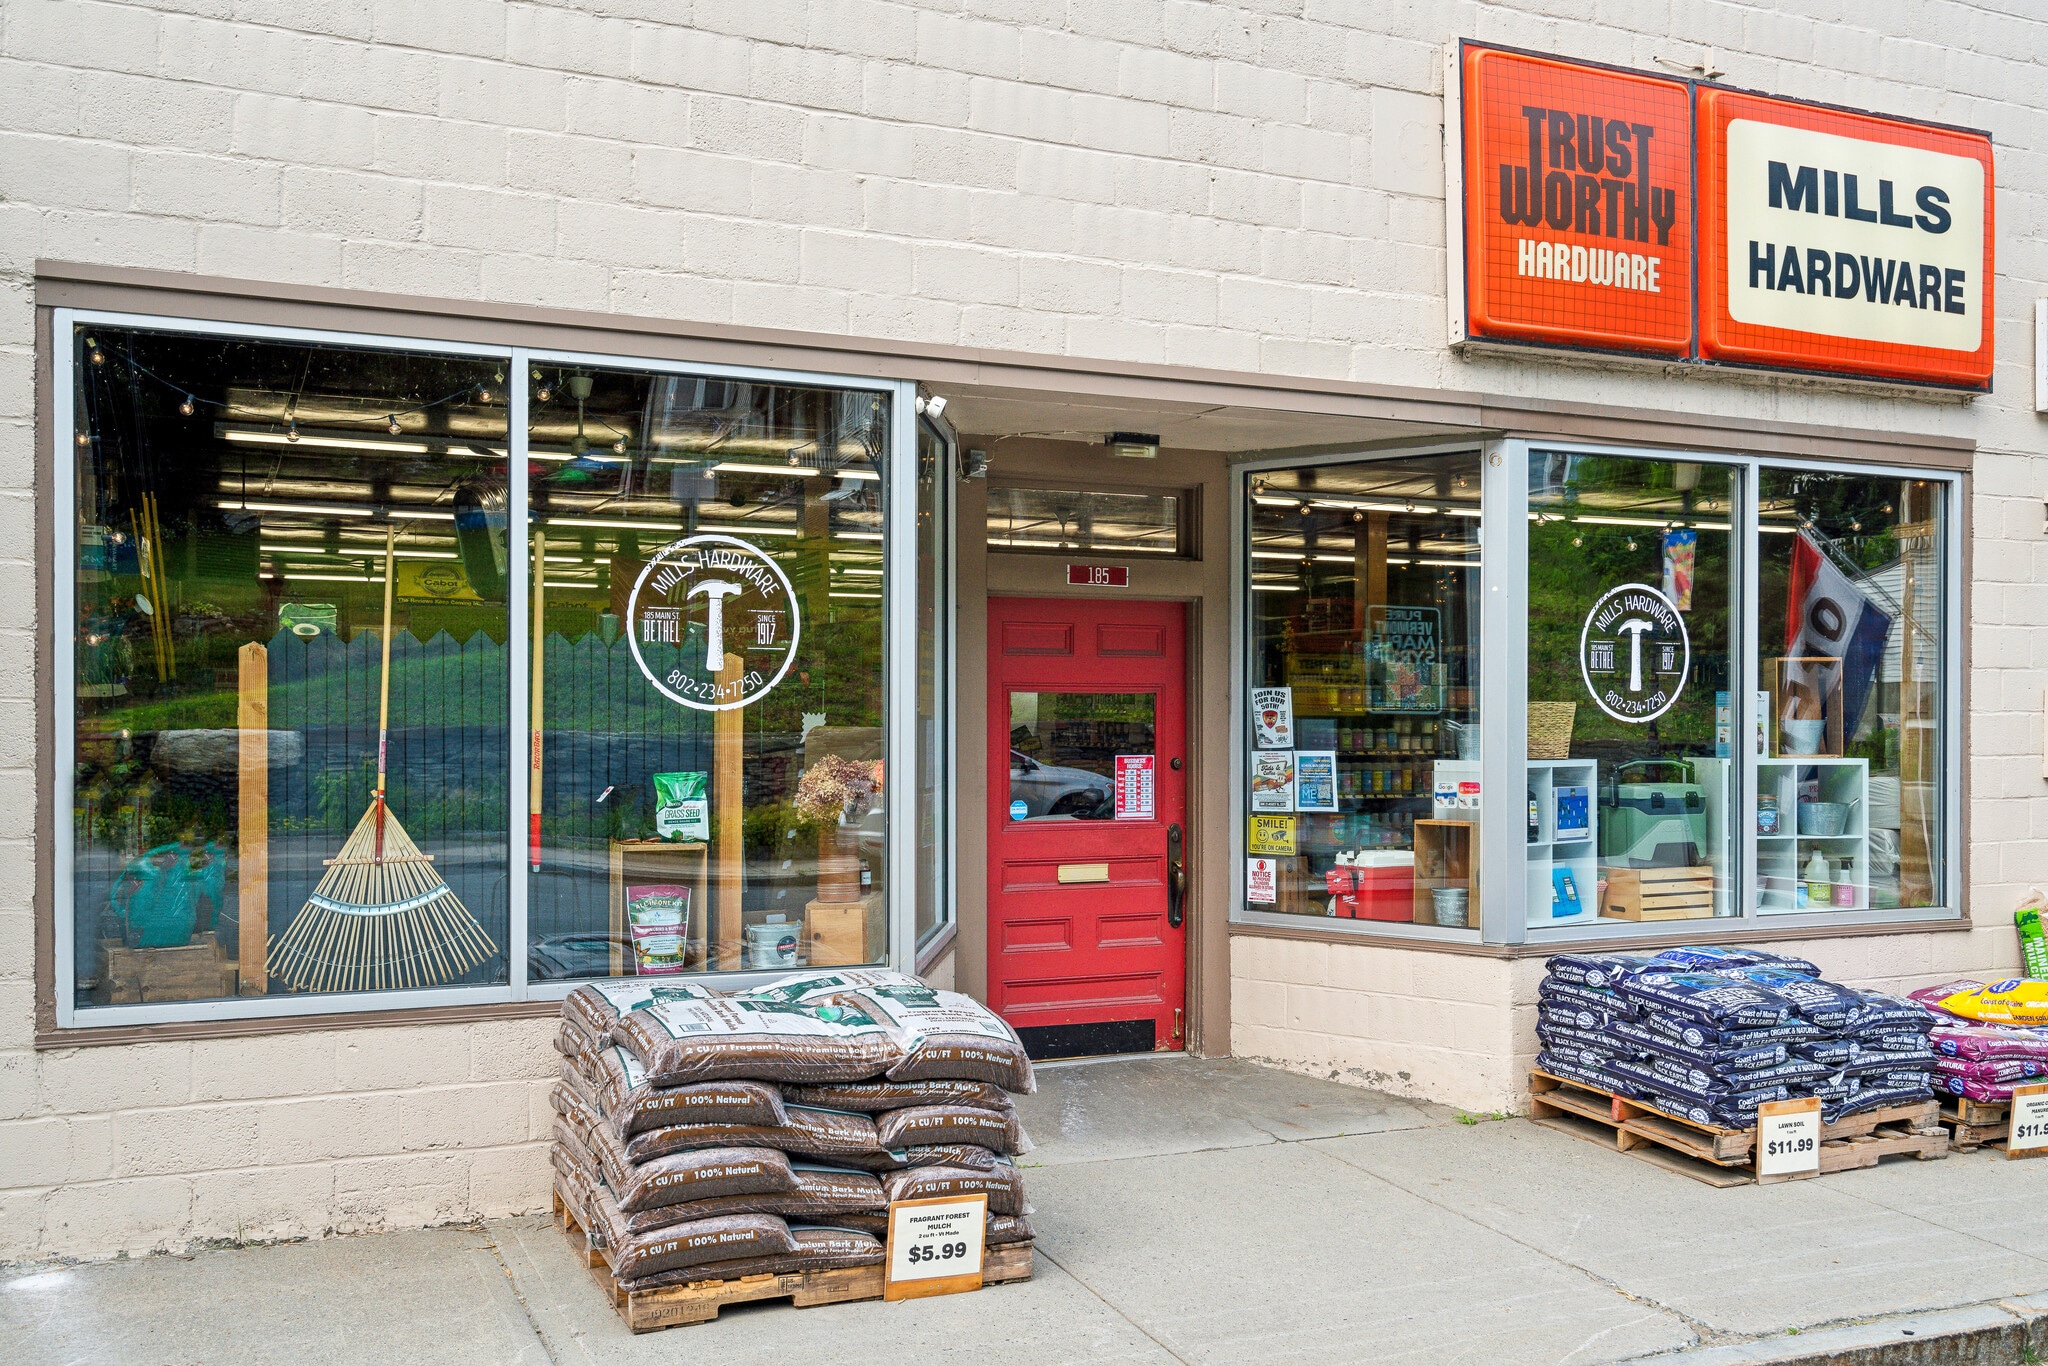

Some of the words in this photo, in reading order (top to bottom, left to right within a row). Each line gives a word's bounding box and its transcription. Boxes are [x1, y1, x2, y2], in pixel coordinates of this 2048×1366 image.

[1522, 105, 1655, 179] TRUST
[1768, 160, 1951, 234] MILLS
[1500, 164, 1675, 245] WORTHY
[1518, 238, 1660, 293] HARDWARE
[1749, 241, 1966, 315] HARDWARE
[651, 556, 695, 596] MILLS
[698, 550, 780, 599] HARDWARE
[1087, 567, 1109, 584] 185
[424, 579, 458, 587] Cabot
[671, 612, 680, 620] ST.
[1595, 599, 1623, 632] MILLS
[1624, 595, 1677, 634] HARDWARE
[644, 620, 680, 642] BETHEL
[758, 623, 776, 645] 1917
[1590, 651, 1614, 669] BETHEL
[1662, 652, 1674, 670] 1917
[1254, 690, 1272, 699] JOIN
[1274, 690, 1286, 698] US
[1255, 697, 1269, 706] FOR
[1270, 697, 1286, 705] OUR
[1261, 764, 1274, 772] Kids
[1302, 789, 1317, 799] ME
[665, 809, 685, 819] GRASS
[686, 809, 700, 817] SEED
[1257, 819, 1288, 829] SMILE!
[1628, 994, 1646, 1005] BLACK
[1645, 1001, 1662, 1011] EARTH
[1667, 1006, 1681, 1016] cubic
[1682, 1011, 1695, 1021] foot
[1763, 1010, 1778, 1018] Maine
[1904, 1036, 1916, 1044] Maine
[696, 1043, 727, 1053] CU/FT
[729, 1044, 772, 1056] Fragrant
[775, 1043, 802, 1052] Forest
[806, 1044, 847, 1054] Premium
[871, 1043, 897, 1052] Mulch
[1758, 1051, 1774, 1060] Maine
[1834, 1048, 1849, 1056] Maine
[637, 1102, 644, 1110] 2
[646, 1098, 674, 1109] CU/FT
[685, 1096, 713, 1105] 100%
[716, 1094, 750, 1104] Natural
[909, 1120, 916, 1128] 2
[918, 1116, 944, 1127] CU/FT
[952, 1116, 977, 1126] 100%
[979, 1118, 1006, 1129] Natural
[908, 1145, 932, 1154] Bark
[934, 1146, 962, 1156] Mulch
[1768, 1138, 1813, 1156] $11.99
[917, 1184, 923, 1193] 2
[924, 1181, 950, 1192] CU/FT
[959, 1180, 984, 1190] 100%
[986, 1181, 1011, 1192] Natural
[910, 1215, 944, 1223] FRAGRANT
[945, 1212, 970, 1220] FOREST
[640, 1248, 647, 1258] 2
[650, 1242, 678, 1254] CU/FT
[688, 1236, 717, 1248] 100%
[720, 1230, 754, 1243] Natural
[908, 1242, 967, 1265] $5.99
